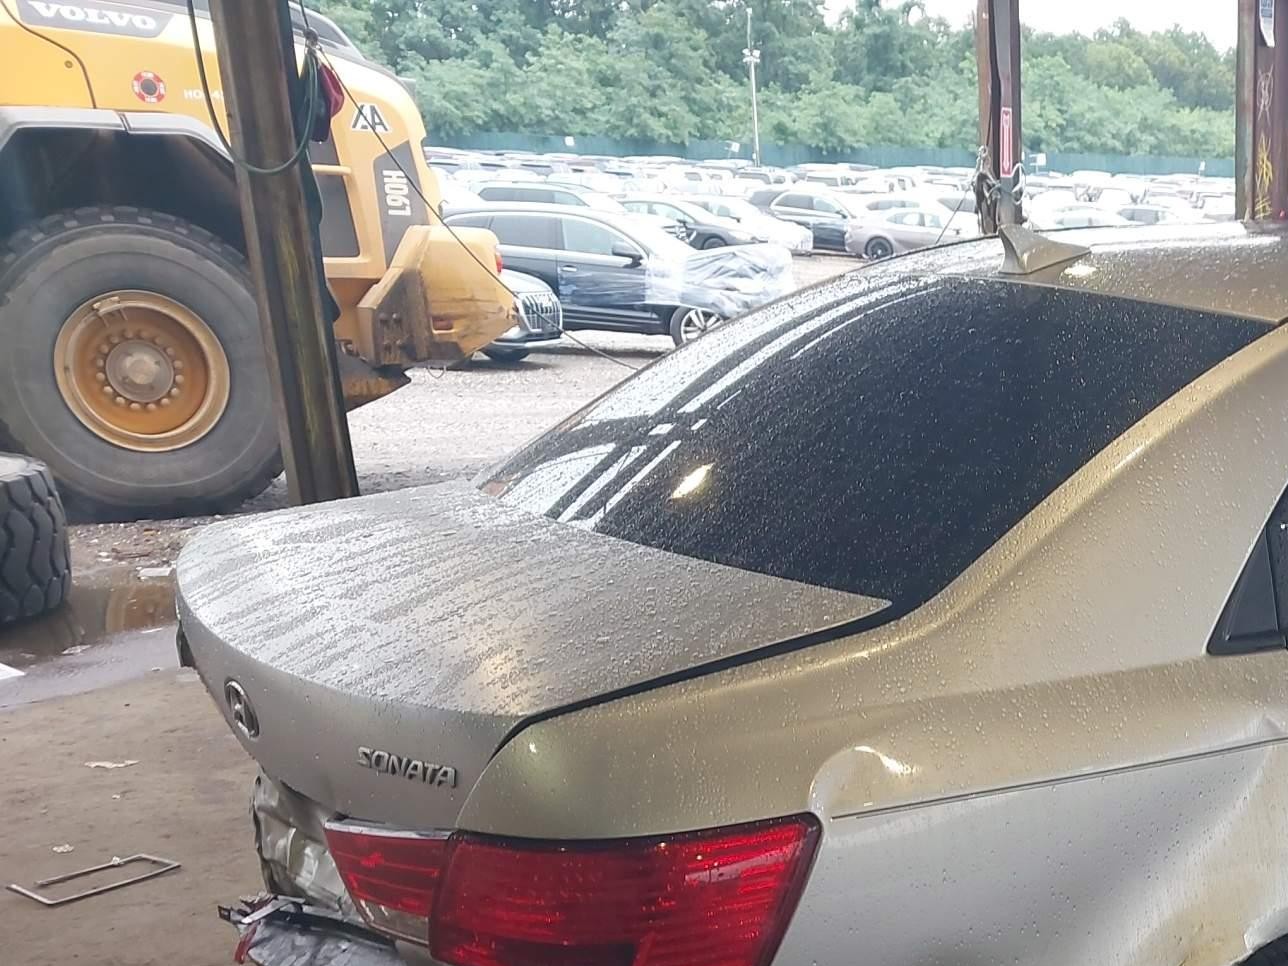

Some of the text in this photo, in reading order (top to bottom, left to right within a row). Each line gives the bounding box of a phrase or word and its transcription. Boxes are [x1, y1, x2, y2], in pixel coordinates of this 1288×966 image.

[26, 1, 157, 30] VOLVO
[382, 169, 412, 216] L90H
[358, 746, 457, 788] SONATA
